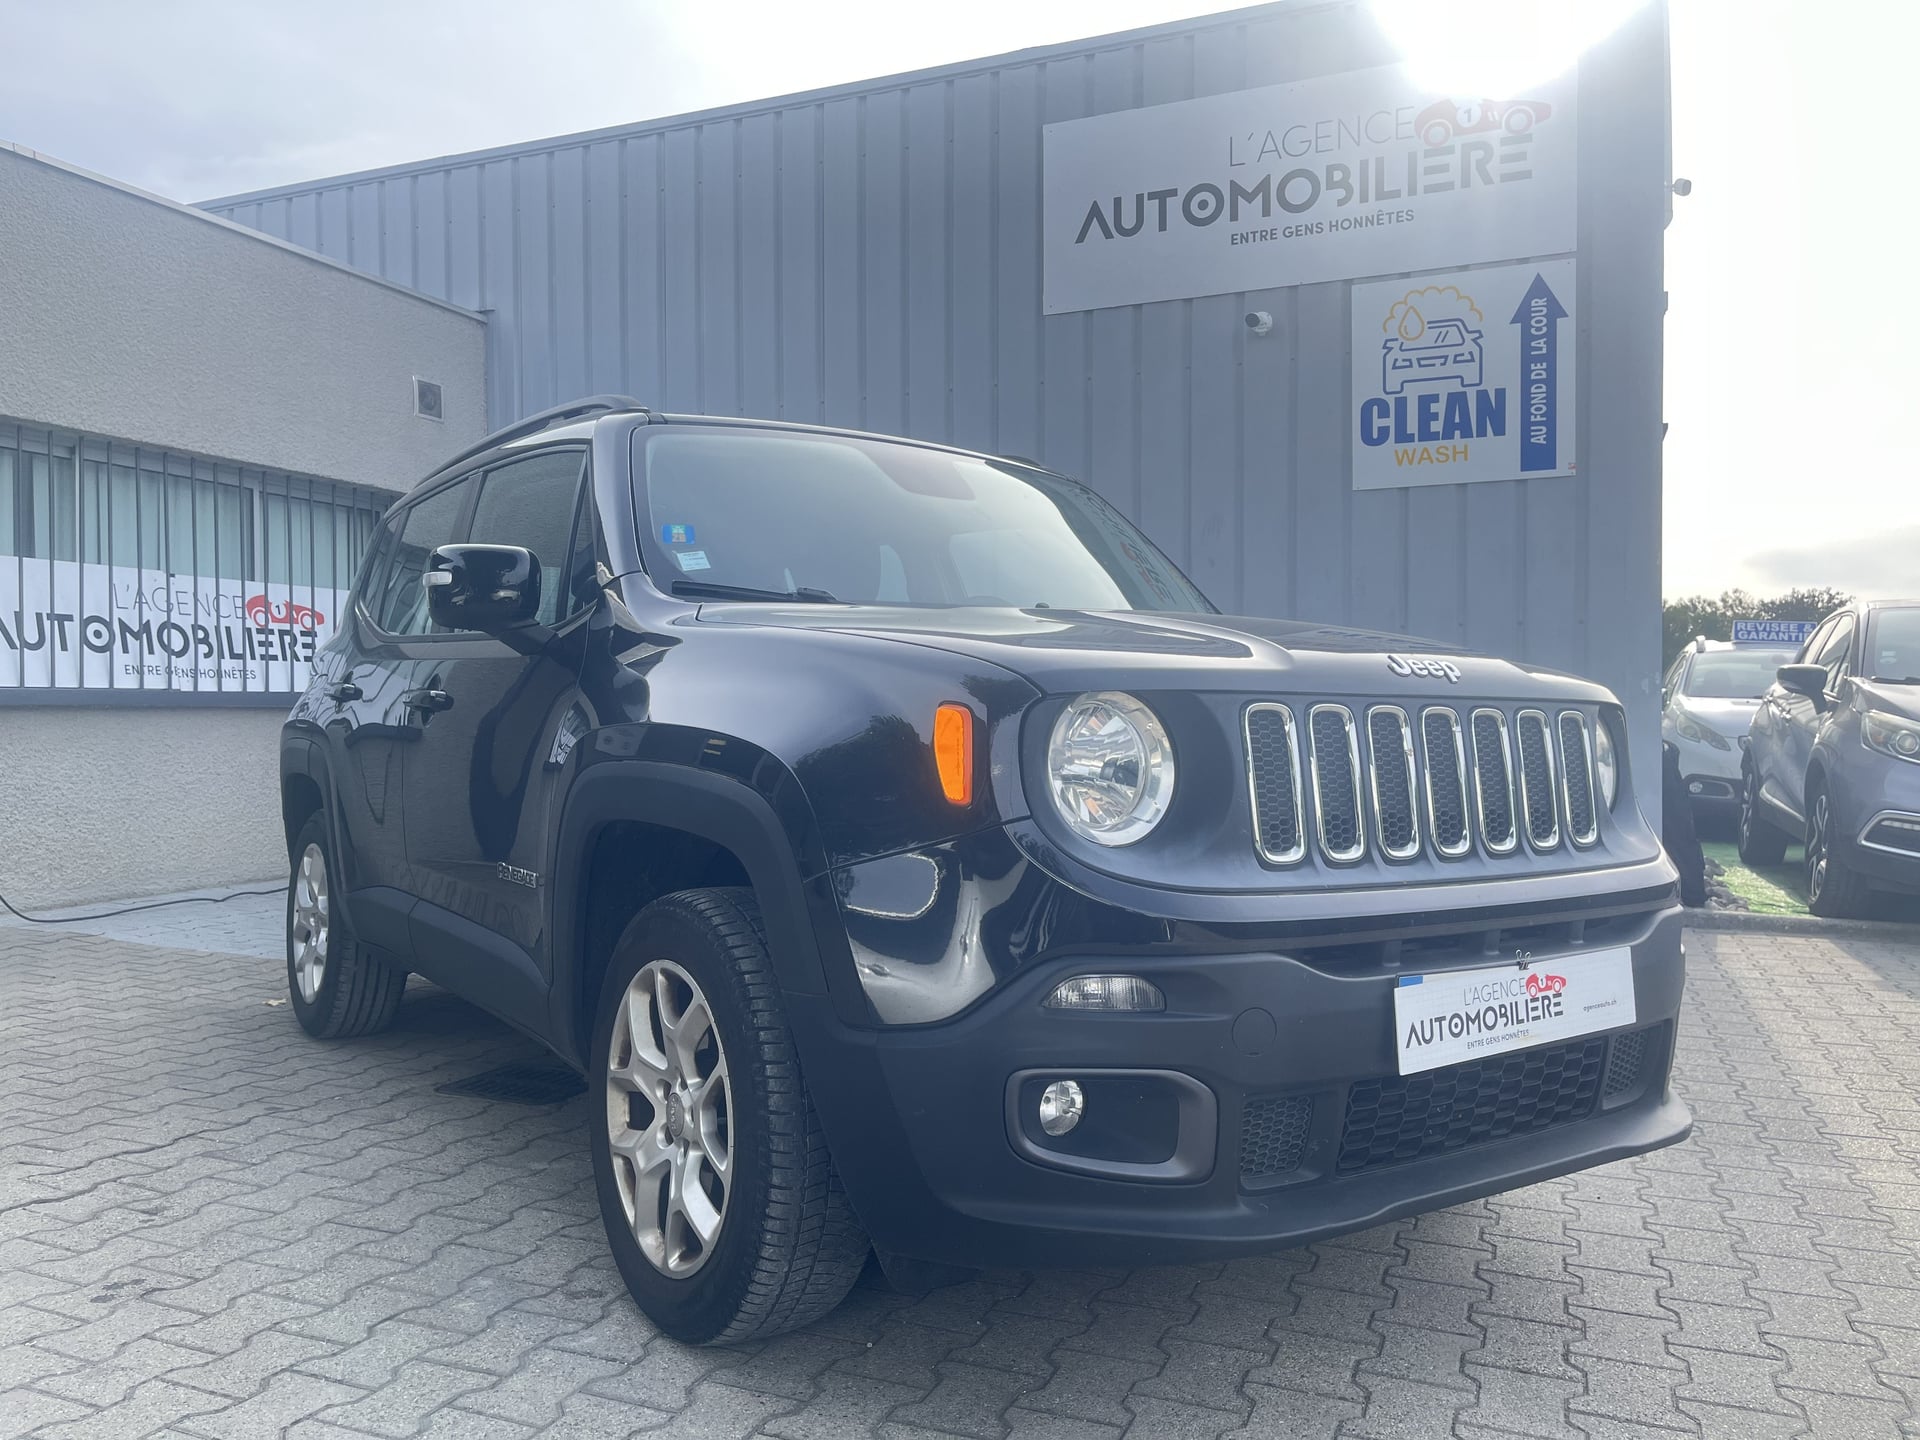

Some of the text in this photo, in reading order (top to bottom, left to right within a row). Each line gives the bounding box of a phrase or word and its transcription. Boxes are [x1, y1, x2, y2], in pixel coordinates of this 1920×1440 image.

[1463, 106, 1473, 122] 1
[1229, 106, 1416, 167] L'AGENCE
[1231, 209, 1415, 246] ENTRE GENS HONNÊTES
[1530, 297, 1547, 444] AU FOND DE LA COUR
[1360, 387, 1507, 447] CLEAN
[1393, 443, 1470, 467] WASH
[113, 584, 248, 620] L'AGENCE
[1737, 622, 1813, 632] REVISEE &
[124, 665, 161, 675] ENTRE
[1387, 654, 1462, 684] Jeep
[1463, 977, 1526, 1006] L'AGENCE
[1467, 1028, 1530, 1050] ENTRE GENS HONNÊTES
